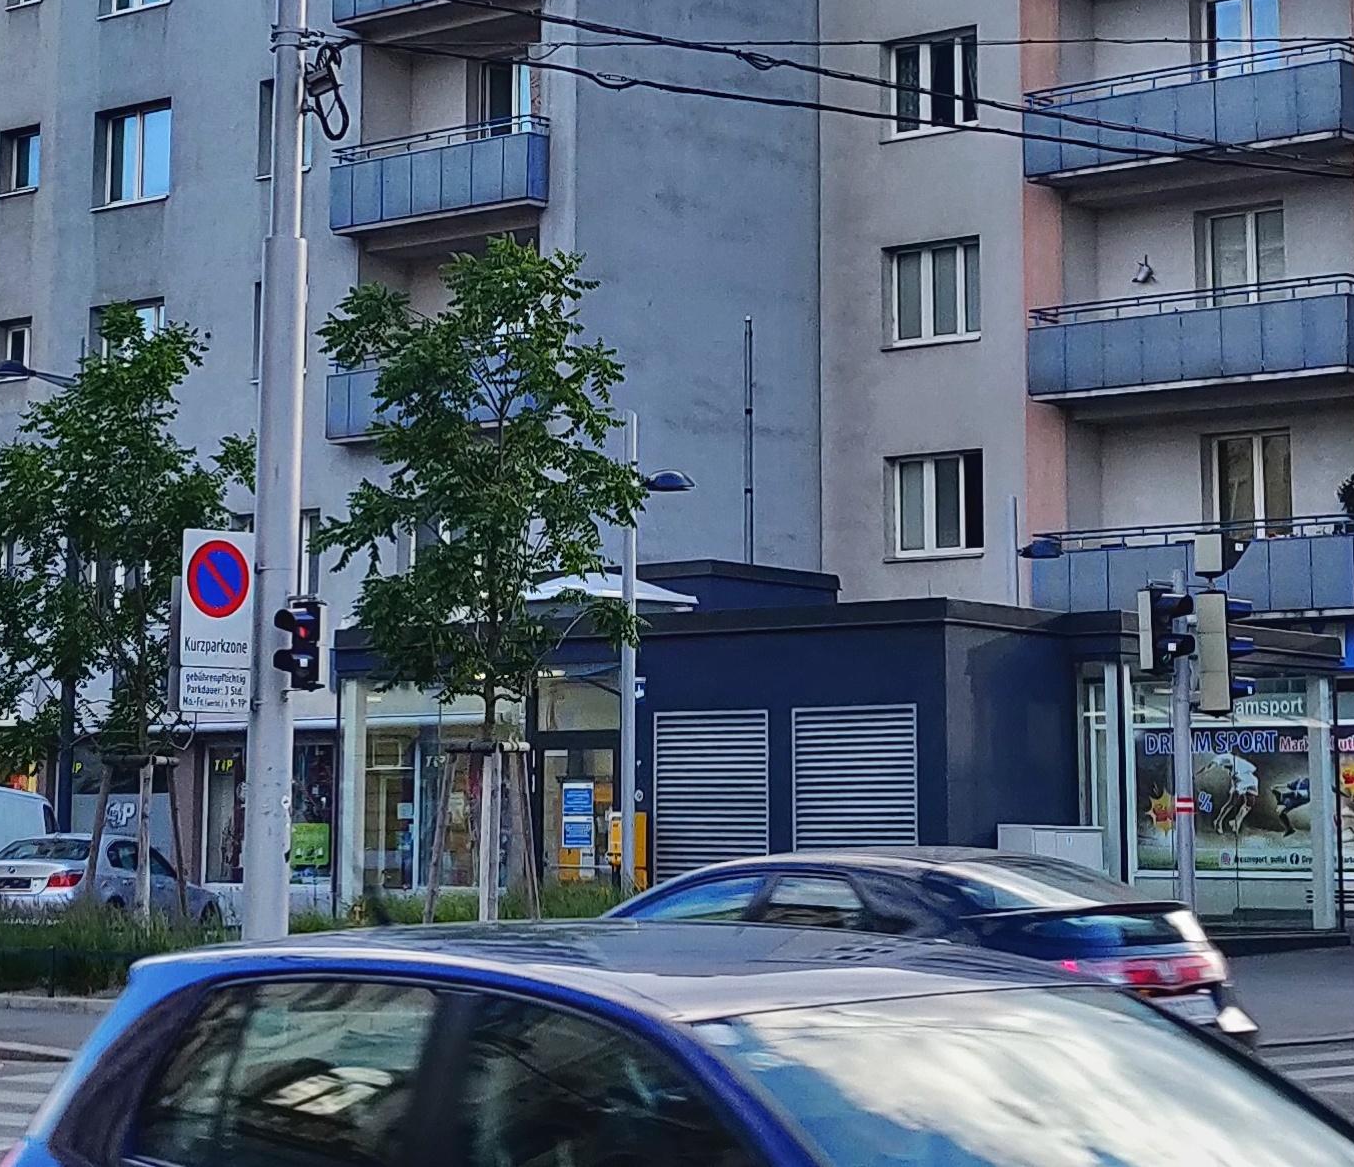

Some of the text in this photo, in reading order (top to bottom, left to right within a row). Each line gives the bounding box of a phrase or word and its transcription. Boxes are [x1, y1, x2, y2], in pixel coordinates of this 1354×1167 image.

[184, 636, 248, 656] Kurzparkzone
[1215, 729, 1278, 754] SPORT
[215, 758, 234, 772] TIP
